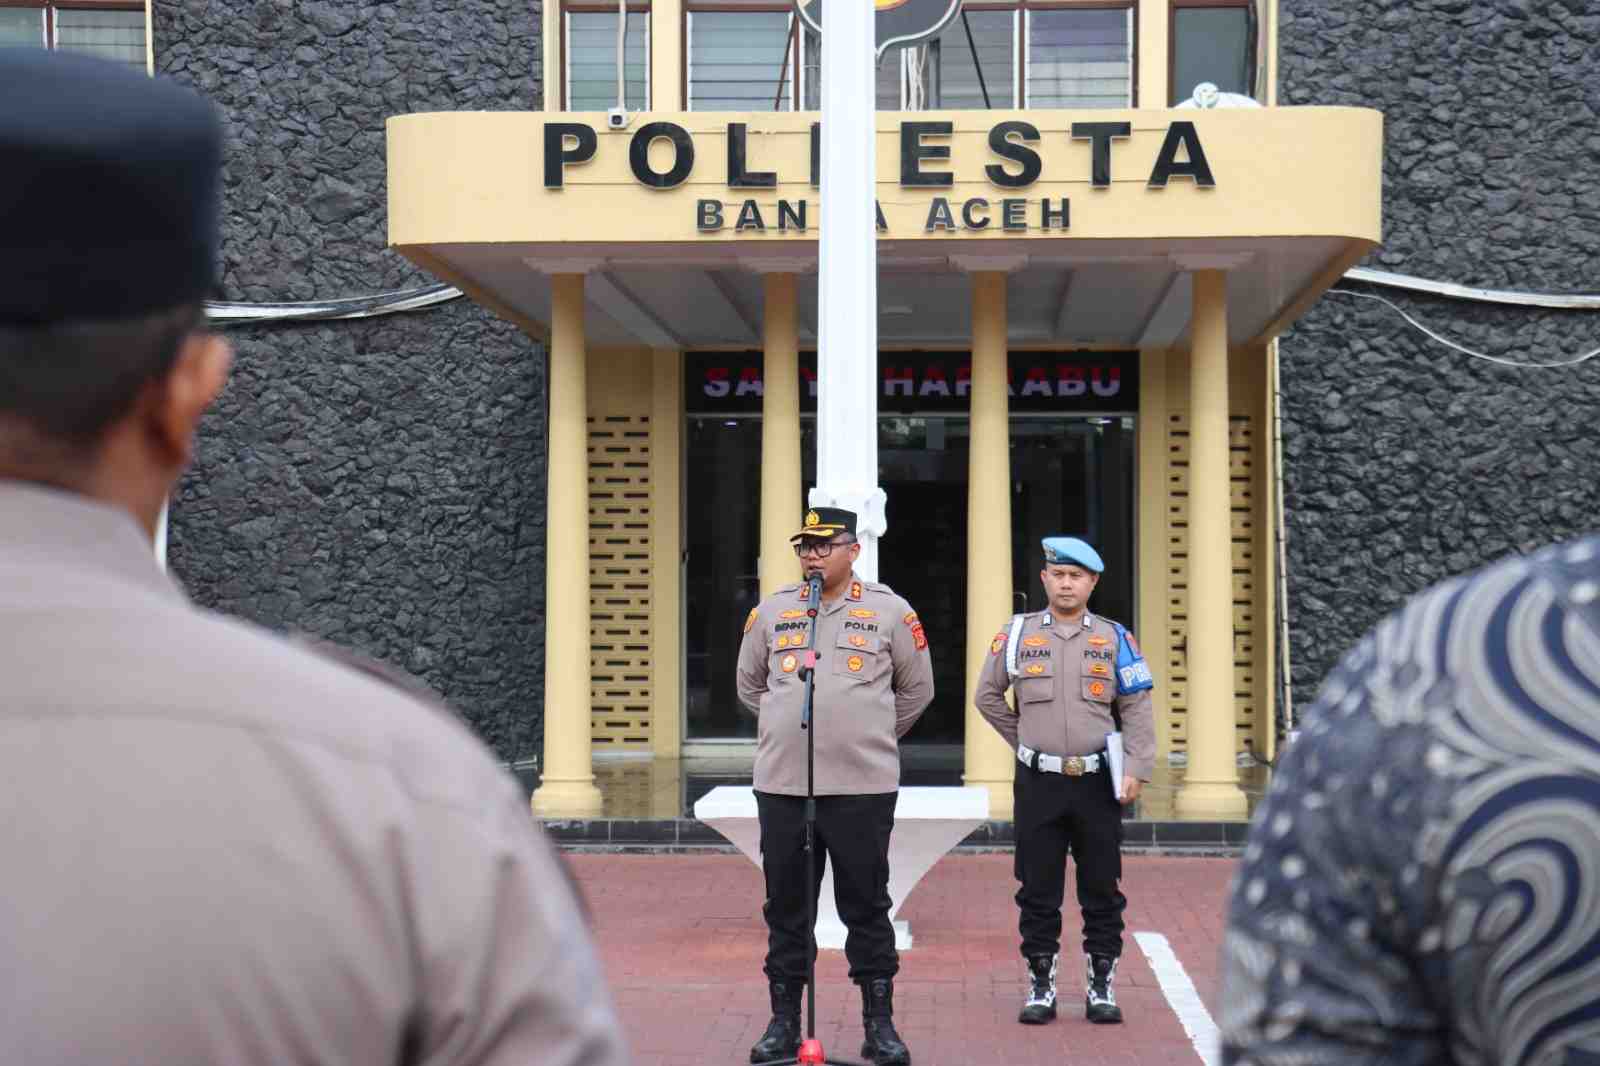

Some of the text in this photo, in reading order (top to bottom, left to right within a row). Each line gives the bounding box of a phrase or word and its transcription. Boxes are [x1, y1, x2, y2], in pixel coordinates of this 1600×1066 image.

[543, 121, 1216, 190] POLESTA
[697, 197, 1071, 233] BAN ACEH
[884, 366, 1121, 398] HAPABU
[844, 621, 879, 633] POLRI
[1084, 649, 1113, 661] POLRI
